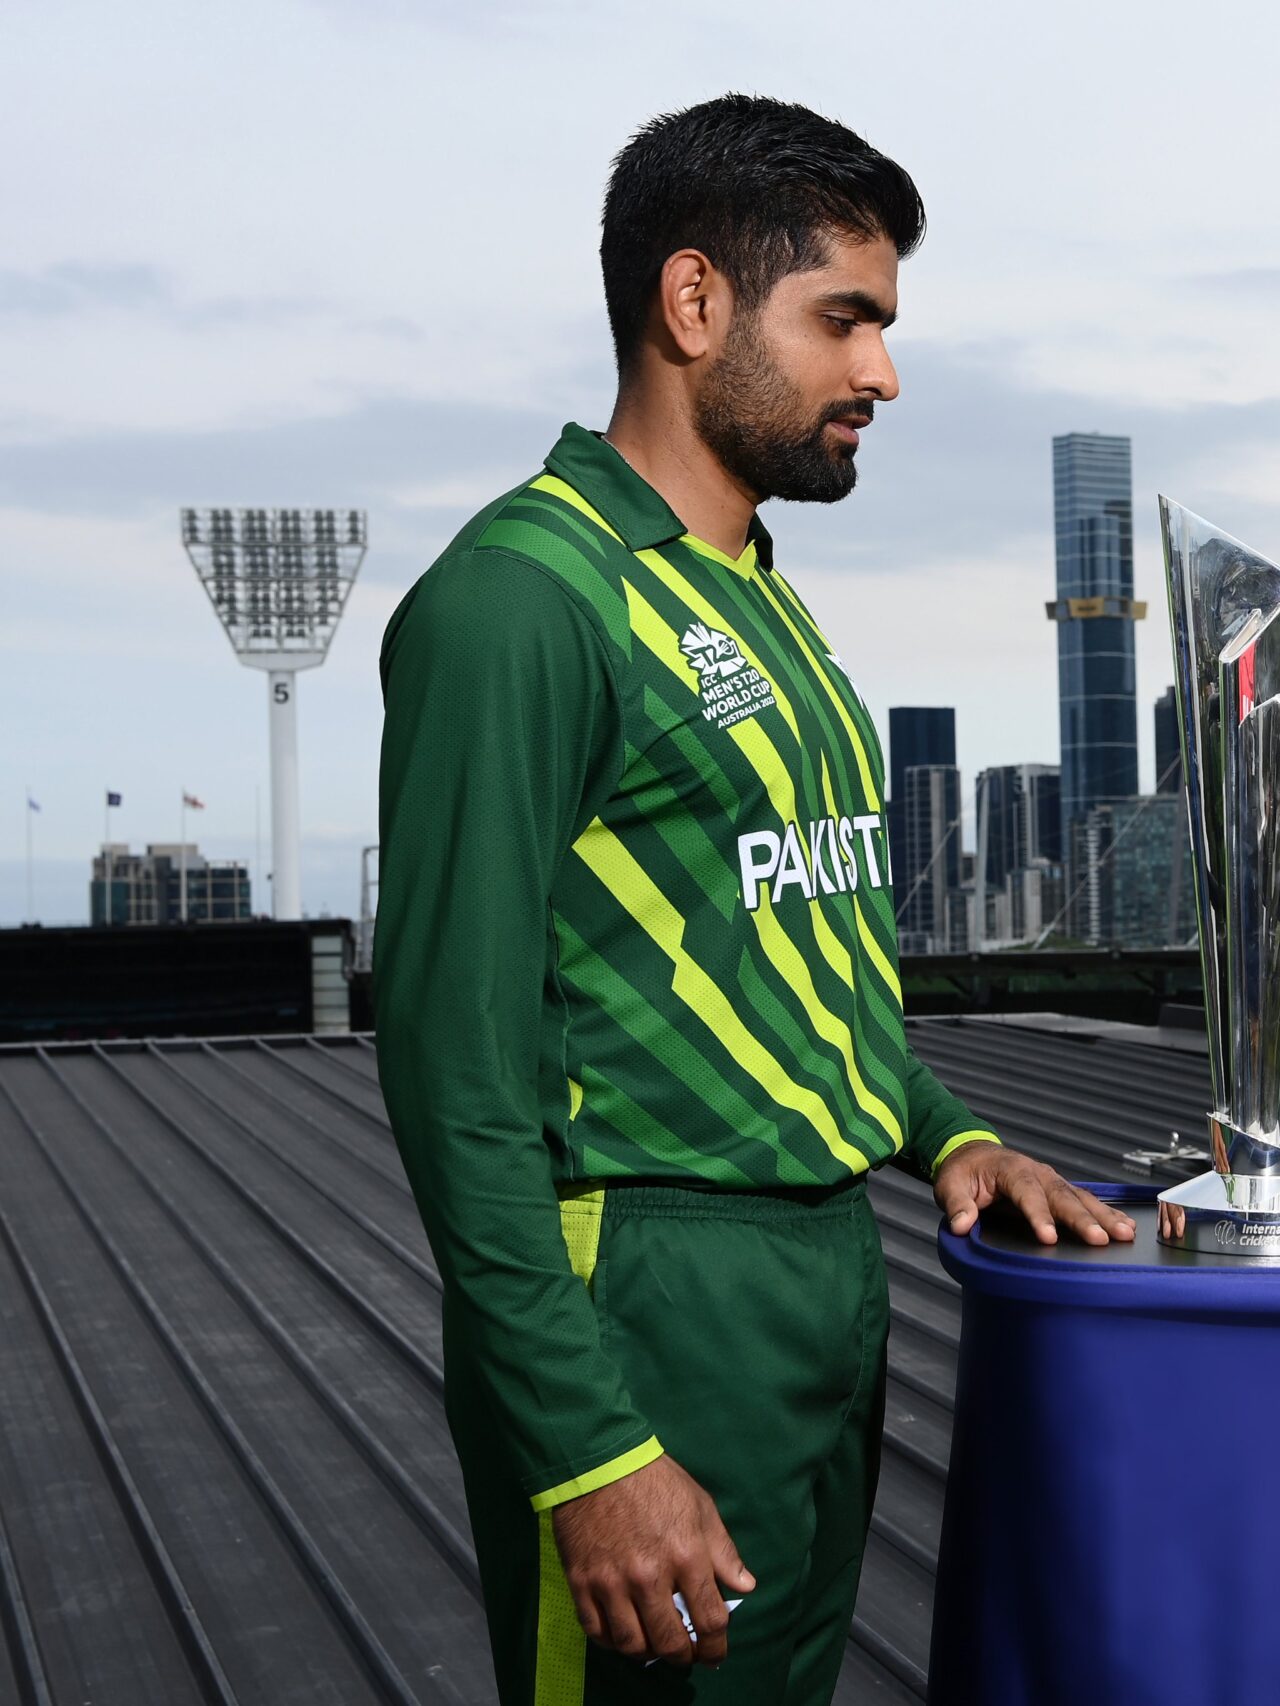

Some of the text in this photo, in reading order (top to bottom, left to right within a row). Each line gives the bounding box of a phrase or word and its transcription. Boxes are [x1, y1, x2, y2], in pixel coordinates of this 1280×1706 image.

[274, 682, 289, 705] 5
[701, 674, 718, 688] ICC
[702, 669, 760, 705] MEN'S T20
[702, 681, 771, 721] WORLD CUP
[718, 696, 776, 729] AUSTRALIA 2022
[738, 814, 893, 909] PAKIST
